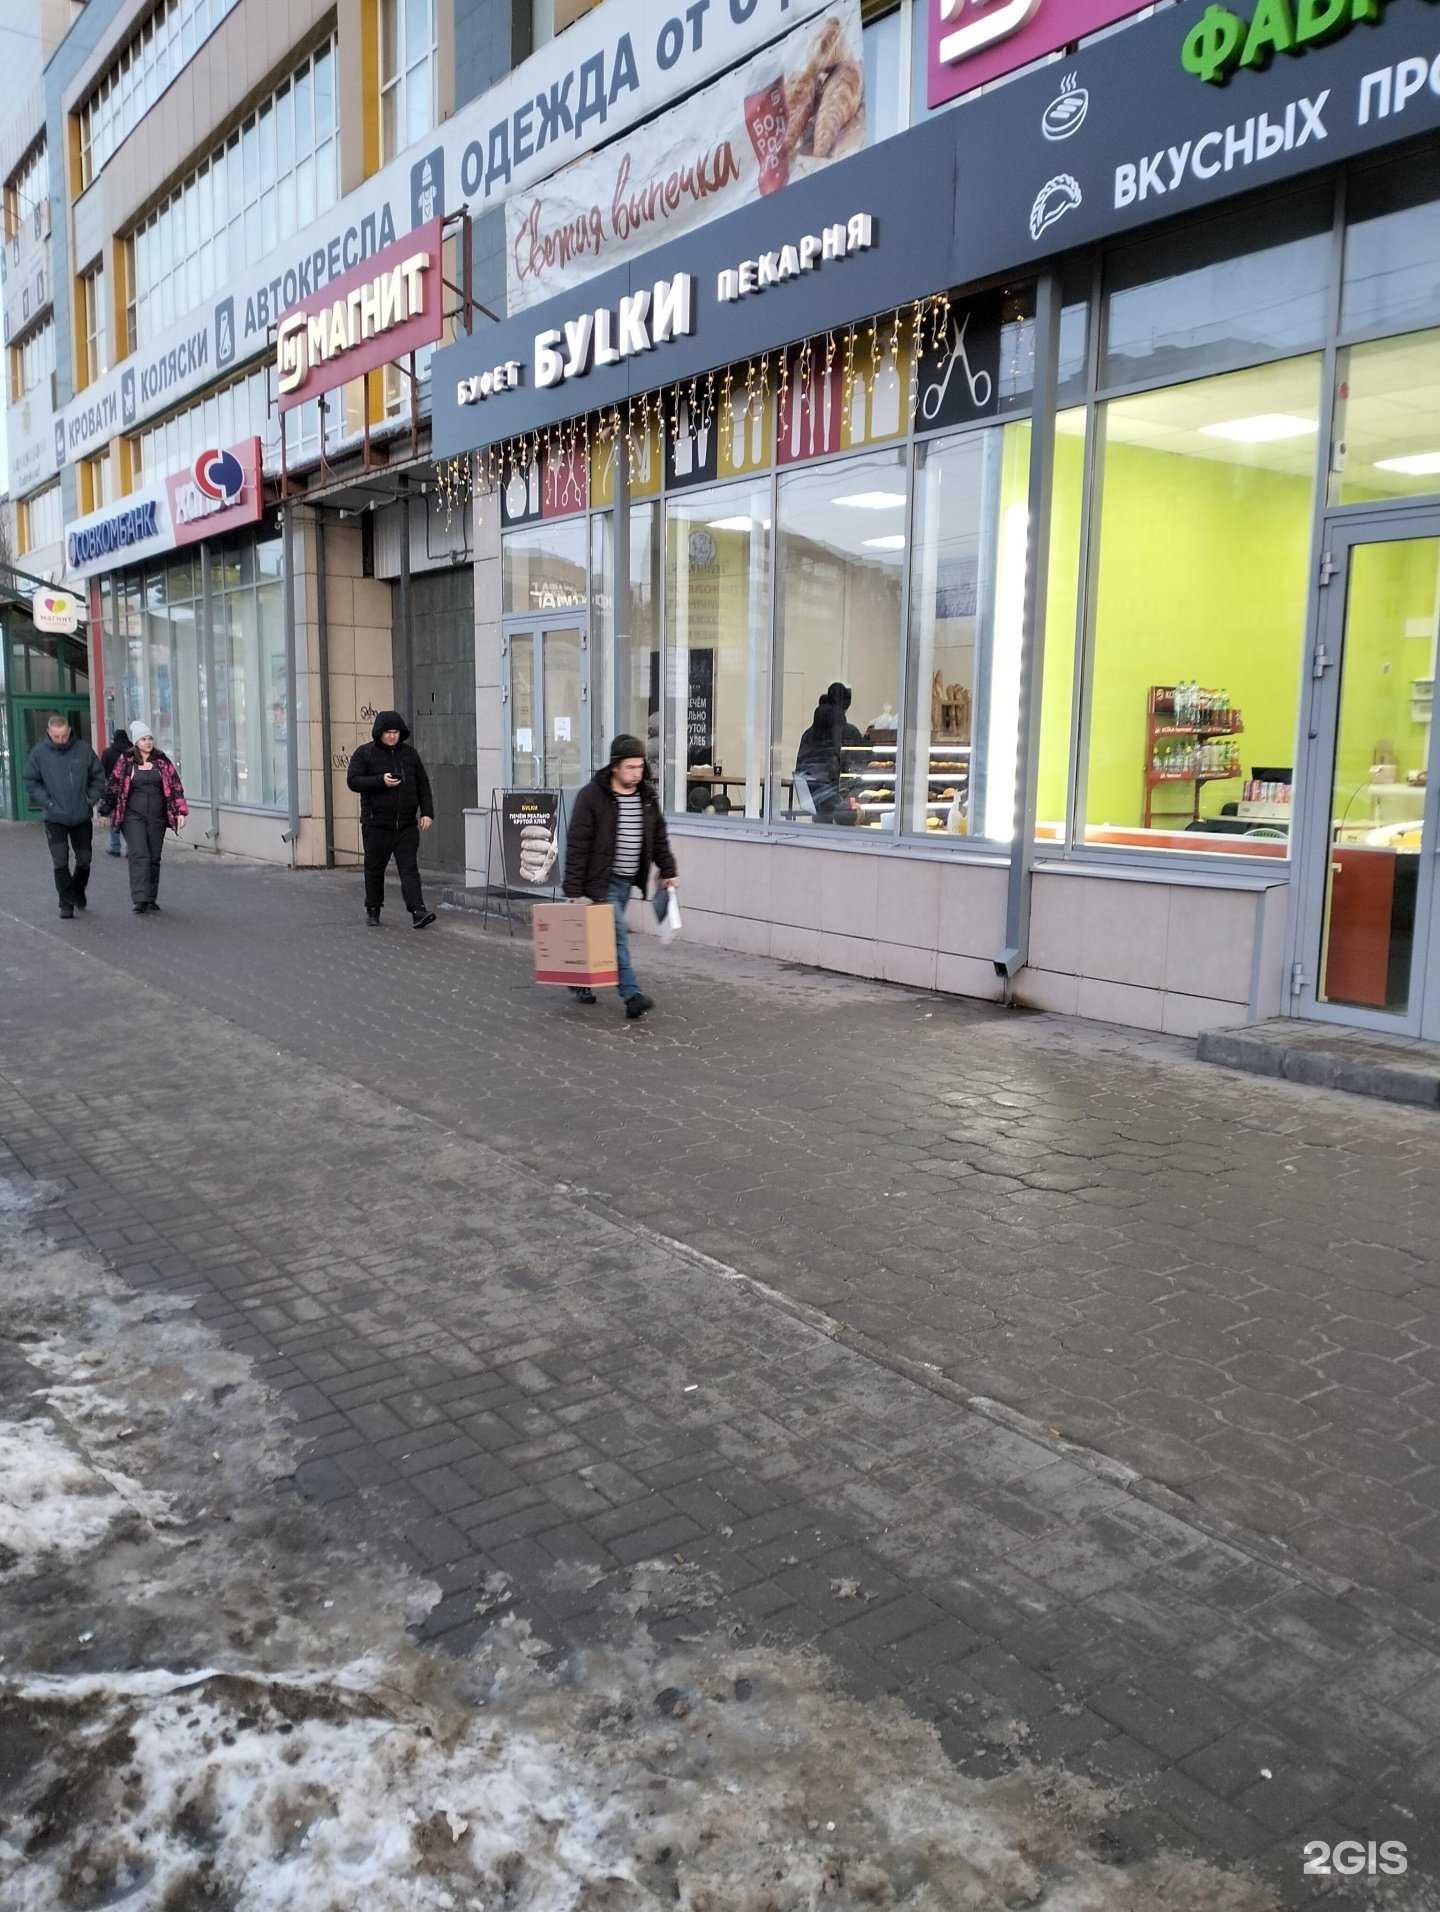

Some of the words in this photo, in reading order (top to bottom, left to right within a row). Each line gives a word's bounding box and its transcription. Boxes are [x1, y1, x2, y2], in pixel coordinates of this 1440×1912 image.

[1114, 89, 1331, 209] ВКУСНЫХ
[68, 391, 118, 449] КРОВАТИ
[141, 328, 208, 403] КОЛЯСКИ
[244, 201, 396, 338] АВТОКРЕСЛА
[461, 32, 640, 198] ОДЕЖДА
[308, 252, 430, 368] МАГНИТ
[457, 360, 521, 405] БУФЕТ
[717, 212, 872, 303] ПЕКАРНЯ
[76, 500, 159, 563] СОВКОМБАНК
